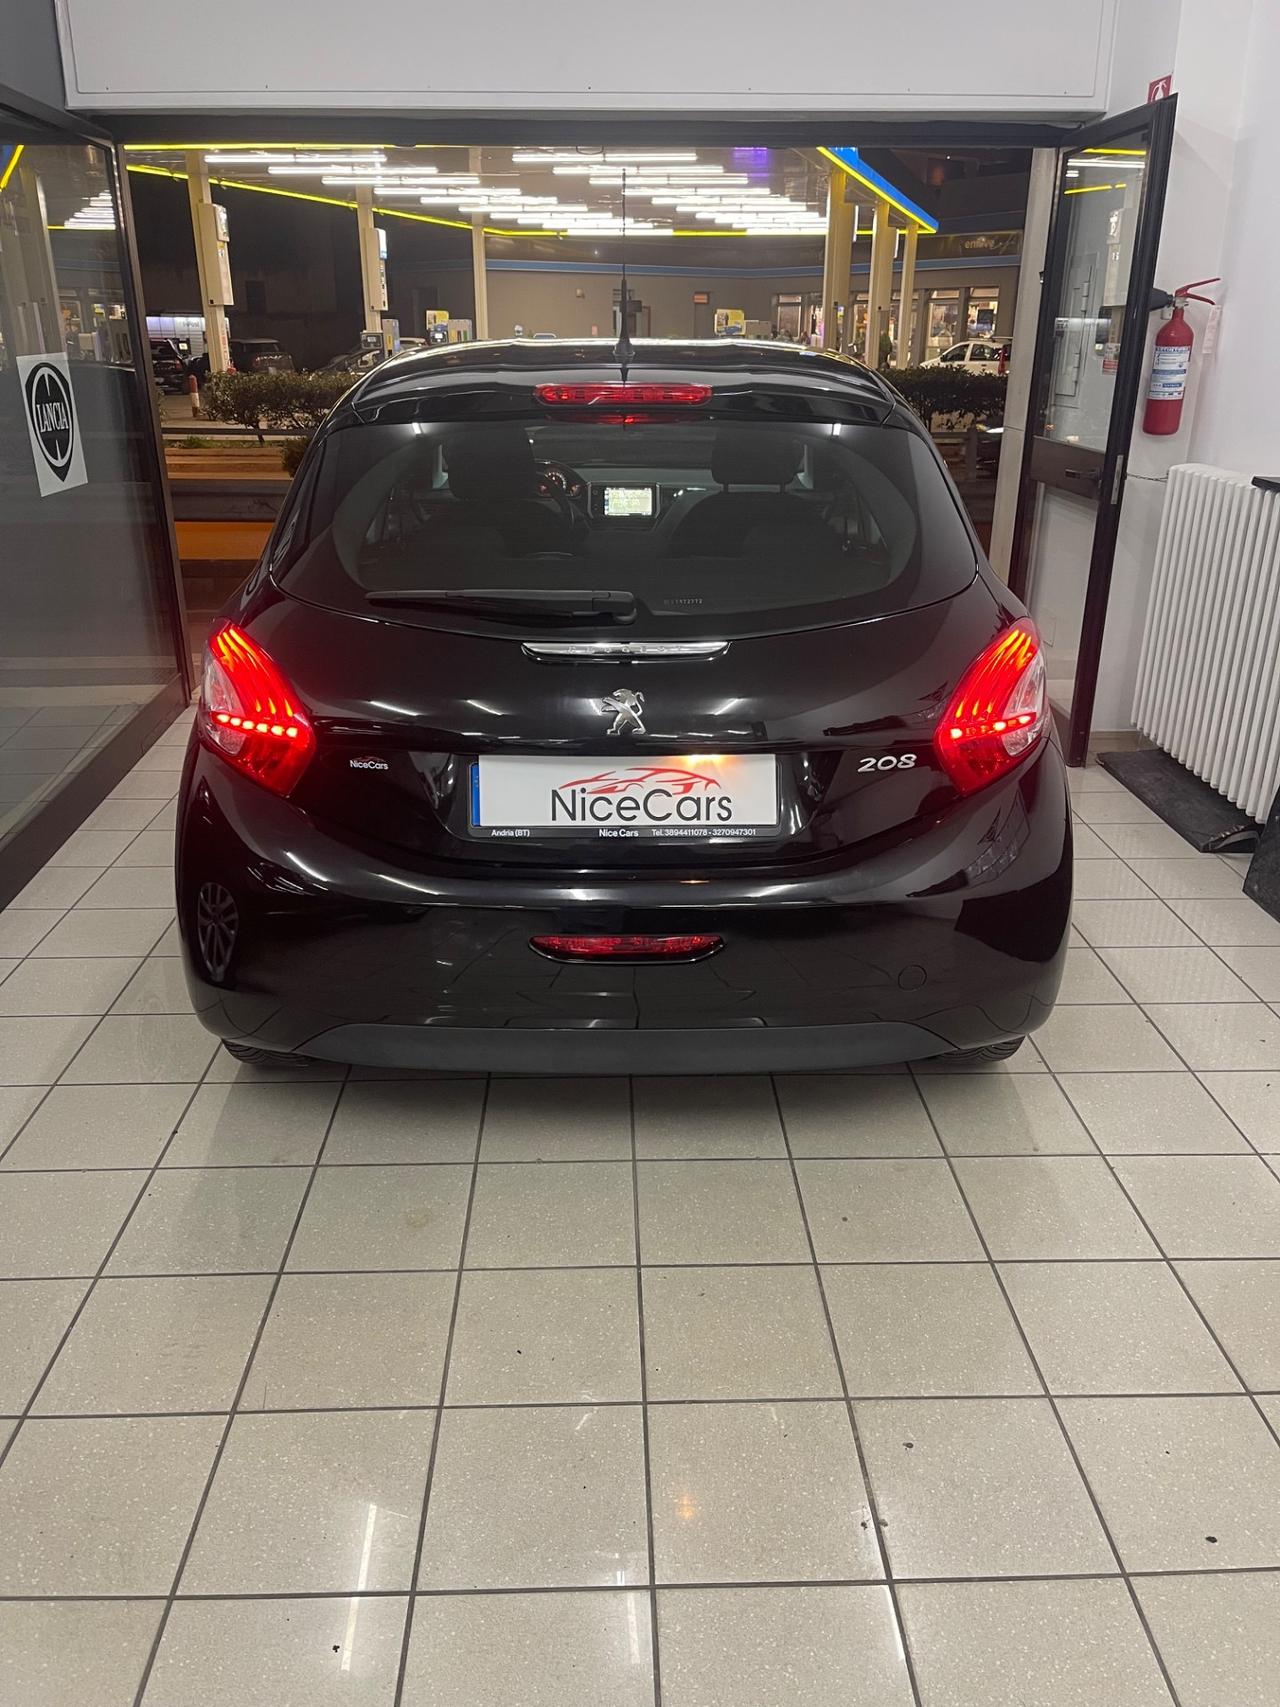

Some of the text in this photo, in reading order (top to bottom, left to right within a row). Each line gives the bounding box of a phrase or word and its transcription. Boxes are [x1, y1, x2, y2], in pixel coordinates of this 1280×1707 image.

[36, 402, 69, 433] LANCIA
[349, 759, 389, 770] NiceCars
[857, 753, 917, 773] 208
[551, 788, 732, 822] NiceCars
[491, 829, 530, 838] Andria (BT)
[599, 829, 639, 838] Nice Cars
